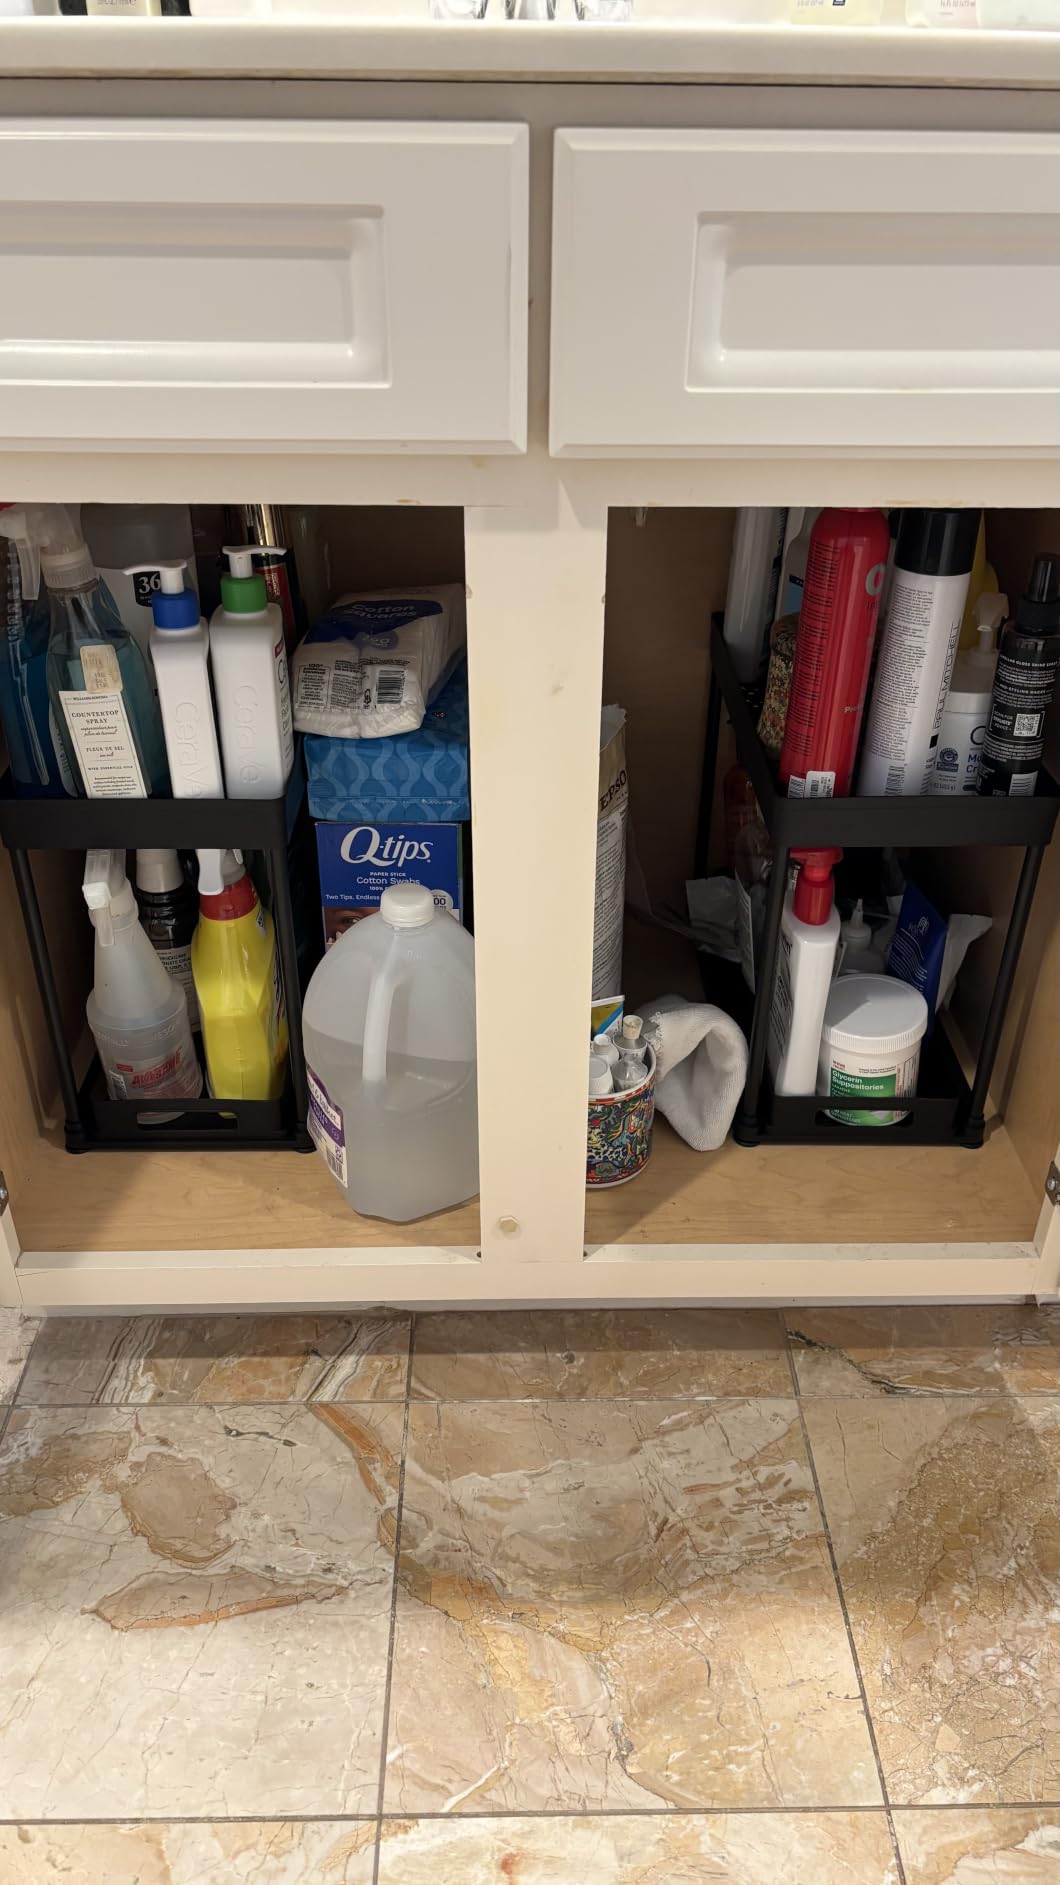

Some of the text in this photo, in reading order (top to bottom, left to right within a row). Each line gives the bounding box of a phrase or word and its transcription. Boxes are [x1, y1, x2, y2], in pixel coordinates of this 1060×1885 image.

[139, 574, 161, 594] 36
[352, 604, 416, 613] Cotton
[933, 621, 961, 729] PAUL MITCHELL
[71, 710, 119, 718] COUNTERTOP
[233, 684, 265, 785] CeraVe
[175, 702, 207, 798] CeraVe
[600, 769, 627, 811] EPSO
[340, 826, 434, 867] Q-tips
[356, 876, 421, 885] Cotton Swabs
[432, 897, 447, 906] 00
[832, 1070, 863, 1084] Glycerin
[832, 1076, 885, 1090] Suppositories
